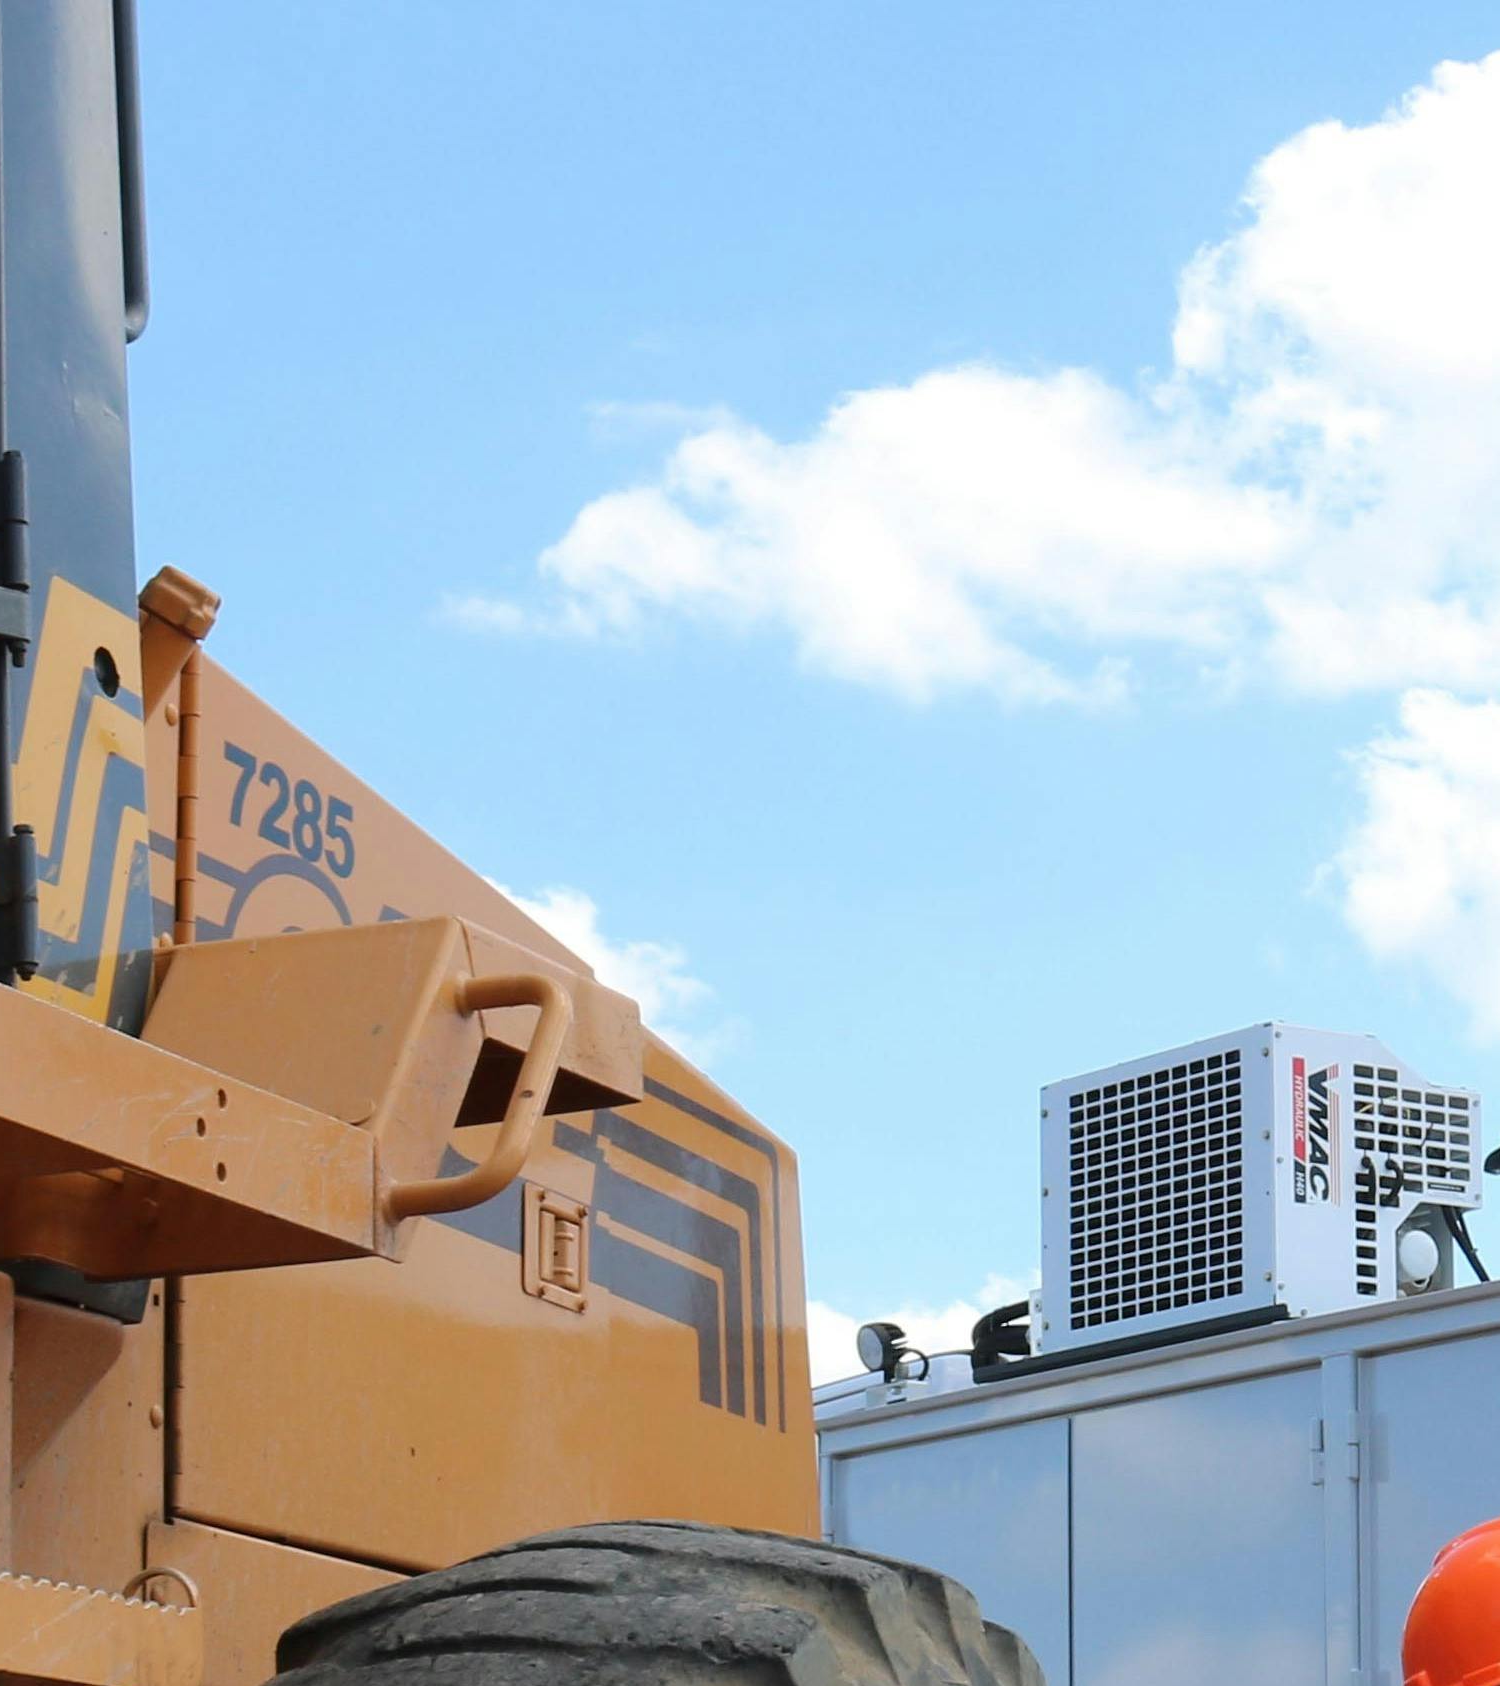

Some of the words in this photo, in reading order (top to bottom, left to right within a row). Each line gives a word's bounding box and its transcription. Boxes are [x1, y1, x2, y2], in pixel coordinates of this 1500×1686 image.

[224, 739, 355, 879] 7285
[1294, 1074, 1305, 1143] HYDRAULIC
[1308, 1067, 1330, 1202] VMAC
[1295, 1171, 1306, 1198] H40
